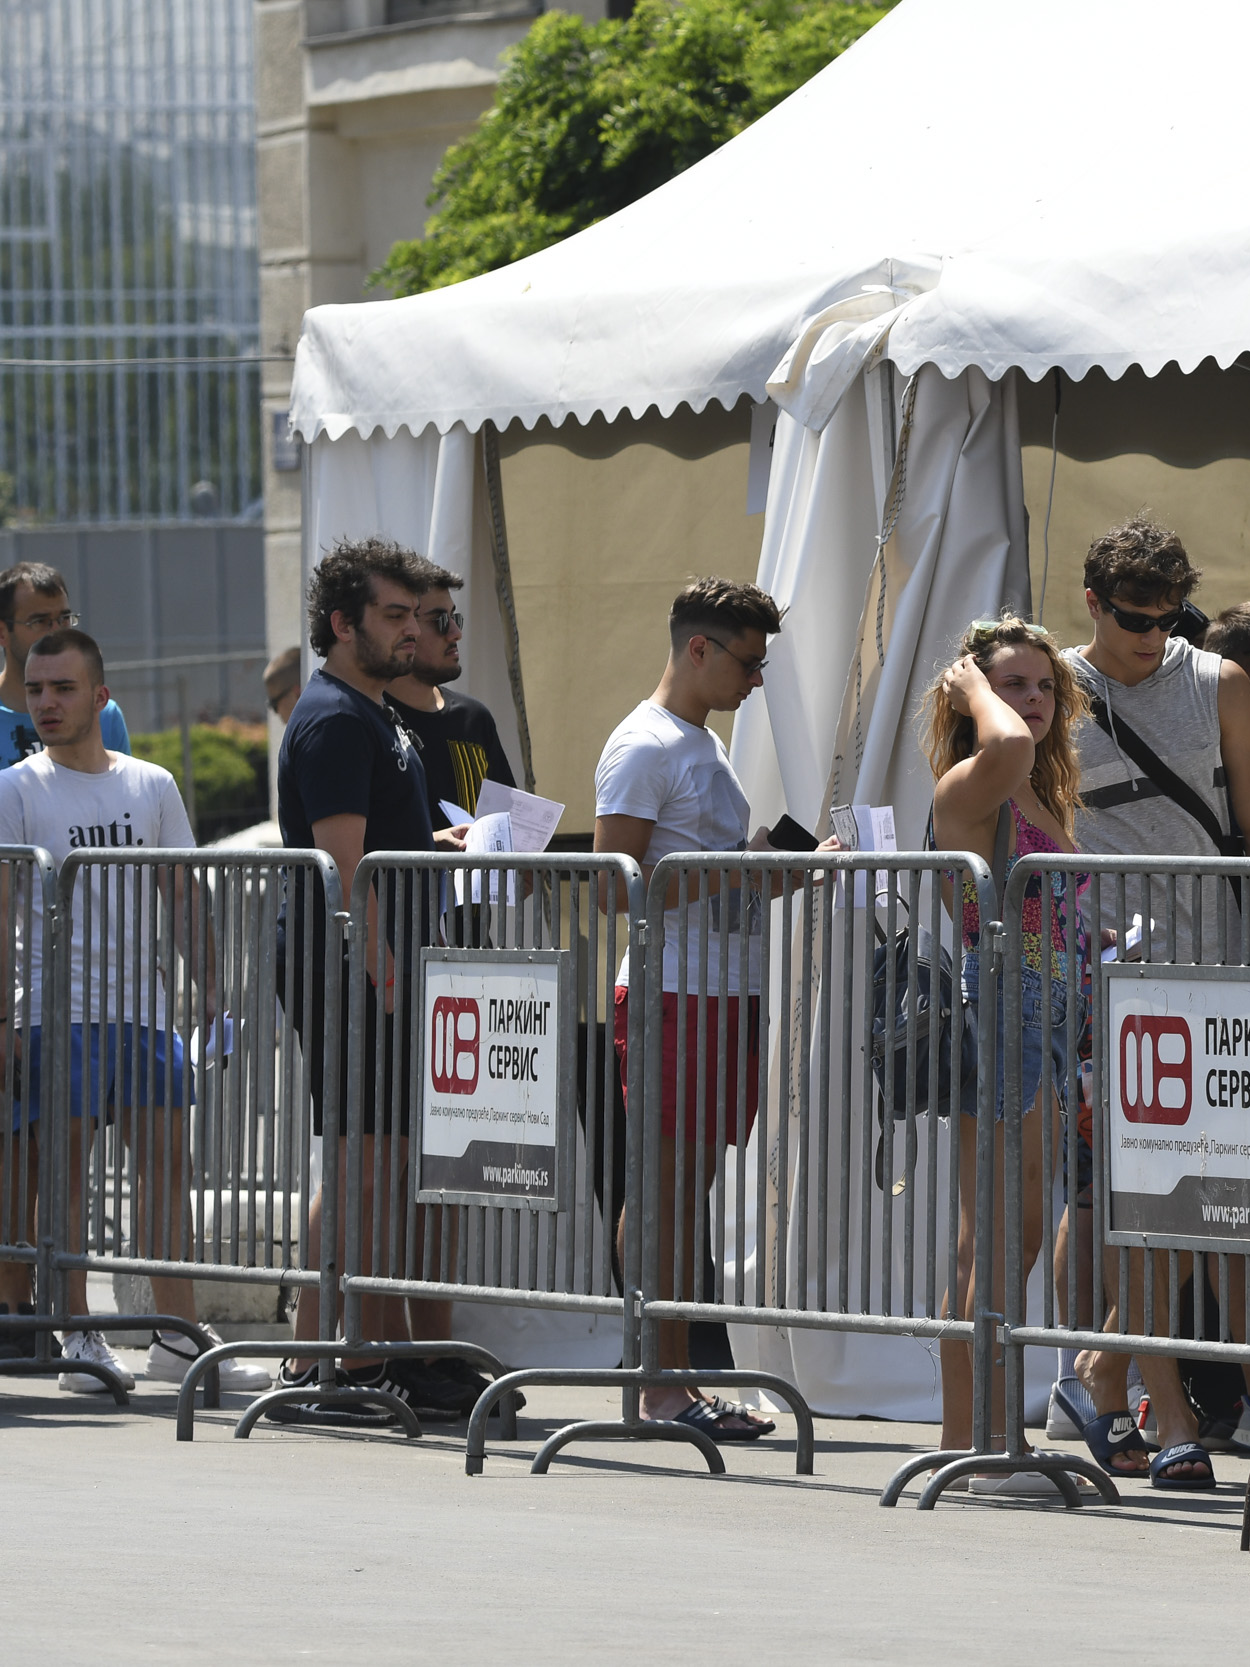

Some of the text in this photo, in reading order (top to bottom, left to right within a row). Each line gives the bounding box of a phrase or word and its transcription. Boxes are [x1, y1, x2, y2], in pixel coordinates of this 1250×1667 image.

[68, 812, 144, 847] anti.
[488, 998, 550, 1036] ПАРКИНГ
[488, 1044, 539, 1082] СЕРВИС
[540, 1111, 549, 1127] Сад
[1139, 1138, 1174, 1154] комунално
[1174, 1139, 1209, 1156] предузеће
[483, 1162, 549, 1190] www.parkingns.rs
[1112, 1416, 1134, 1432] NIKE
[1167, 1443, 1197, 1457] NIKE
